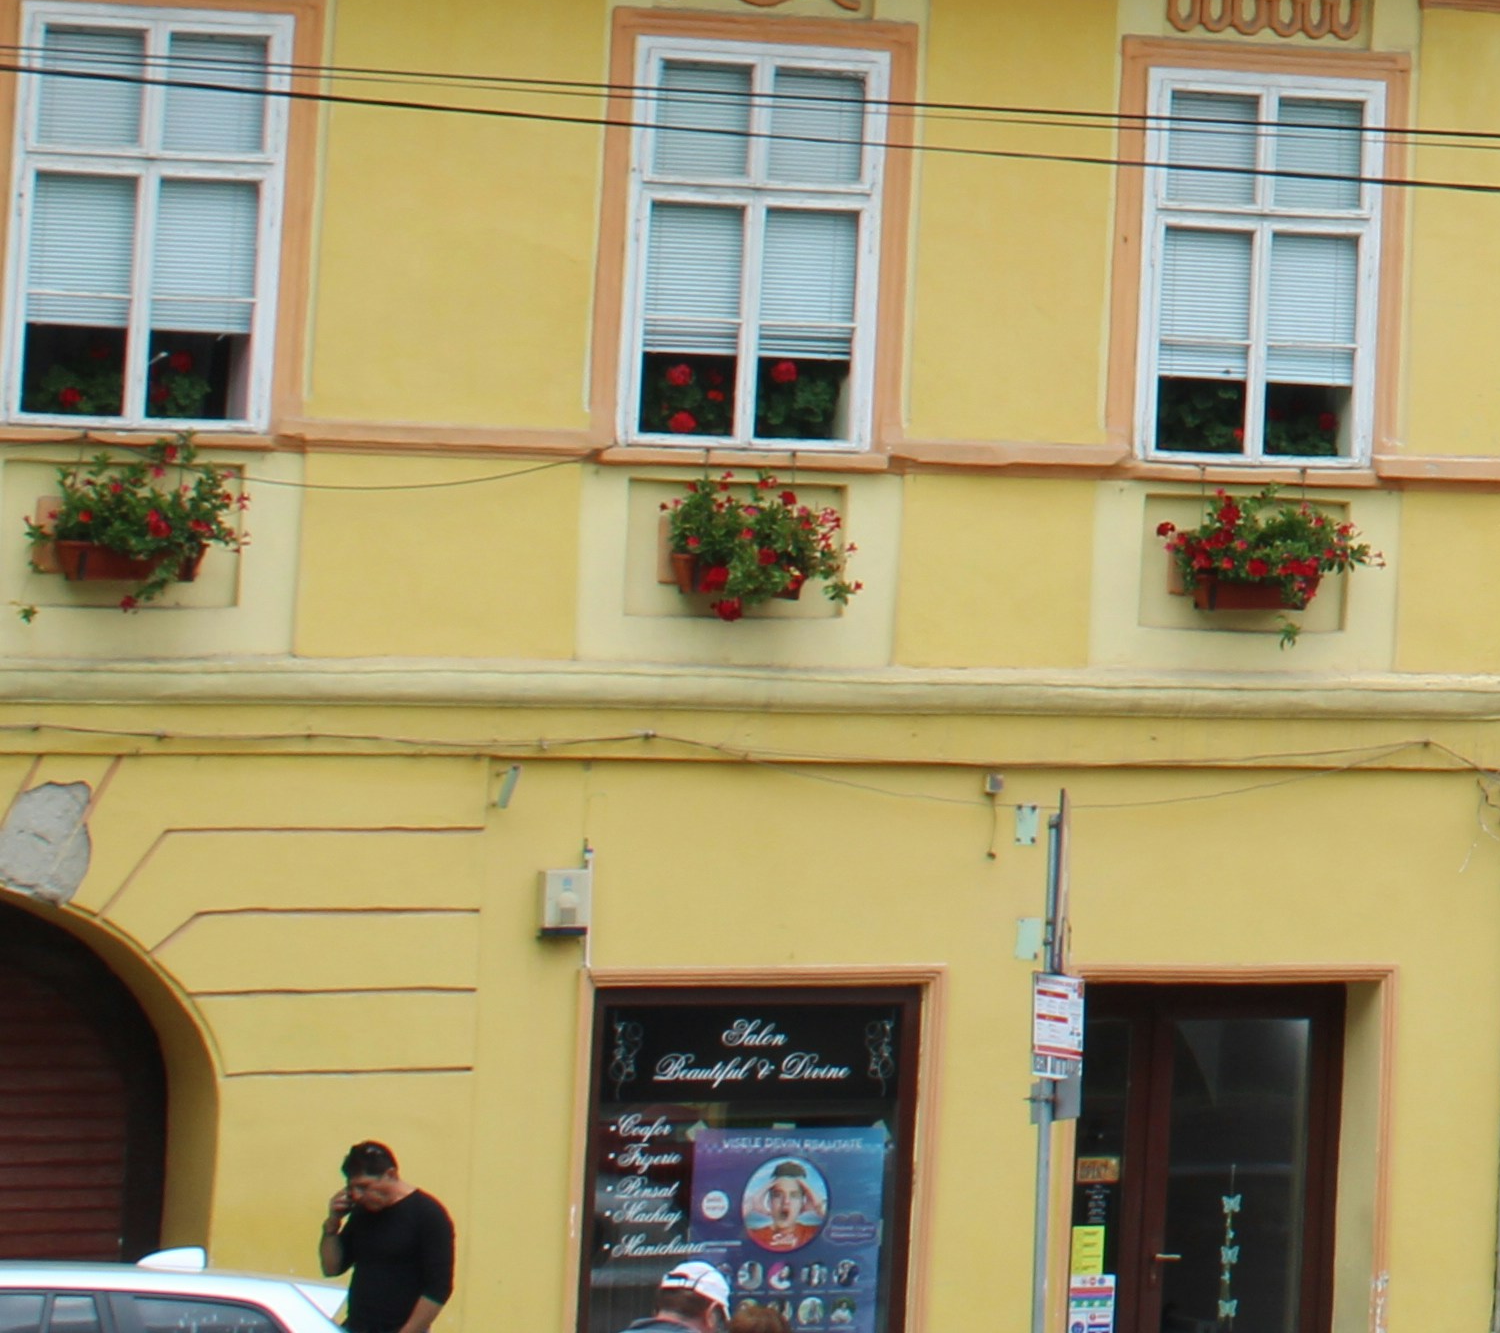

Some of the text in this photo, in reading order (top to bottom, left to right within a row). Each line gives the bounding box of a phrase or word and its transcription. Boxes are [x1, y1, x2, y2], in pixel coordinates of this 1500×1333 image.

[722, 1019, 787, 1046] Salon
[653, 1052, 850, 1088] Beautiful & Divine
[618, 1113, 672, 1142] Coafor
[722, 1137, 761, 1149] VISELE
[765, 1137, 800, 1149] DEVIN
[617, 1143, 682, 1174] Frizerie
[615, 1175, 680, 1198] Pensat
[612, 1201, 682, 1231] Machiaj
[612, 1234, 704, 1257] Manichiura
